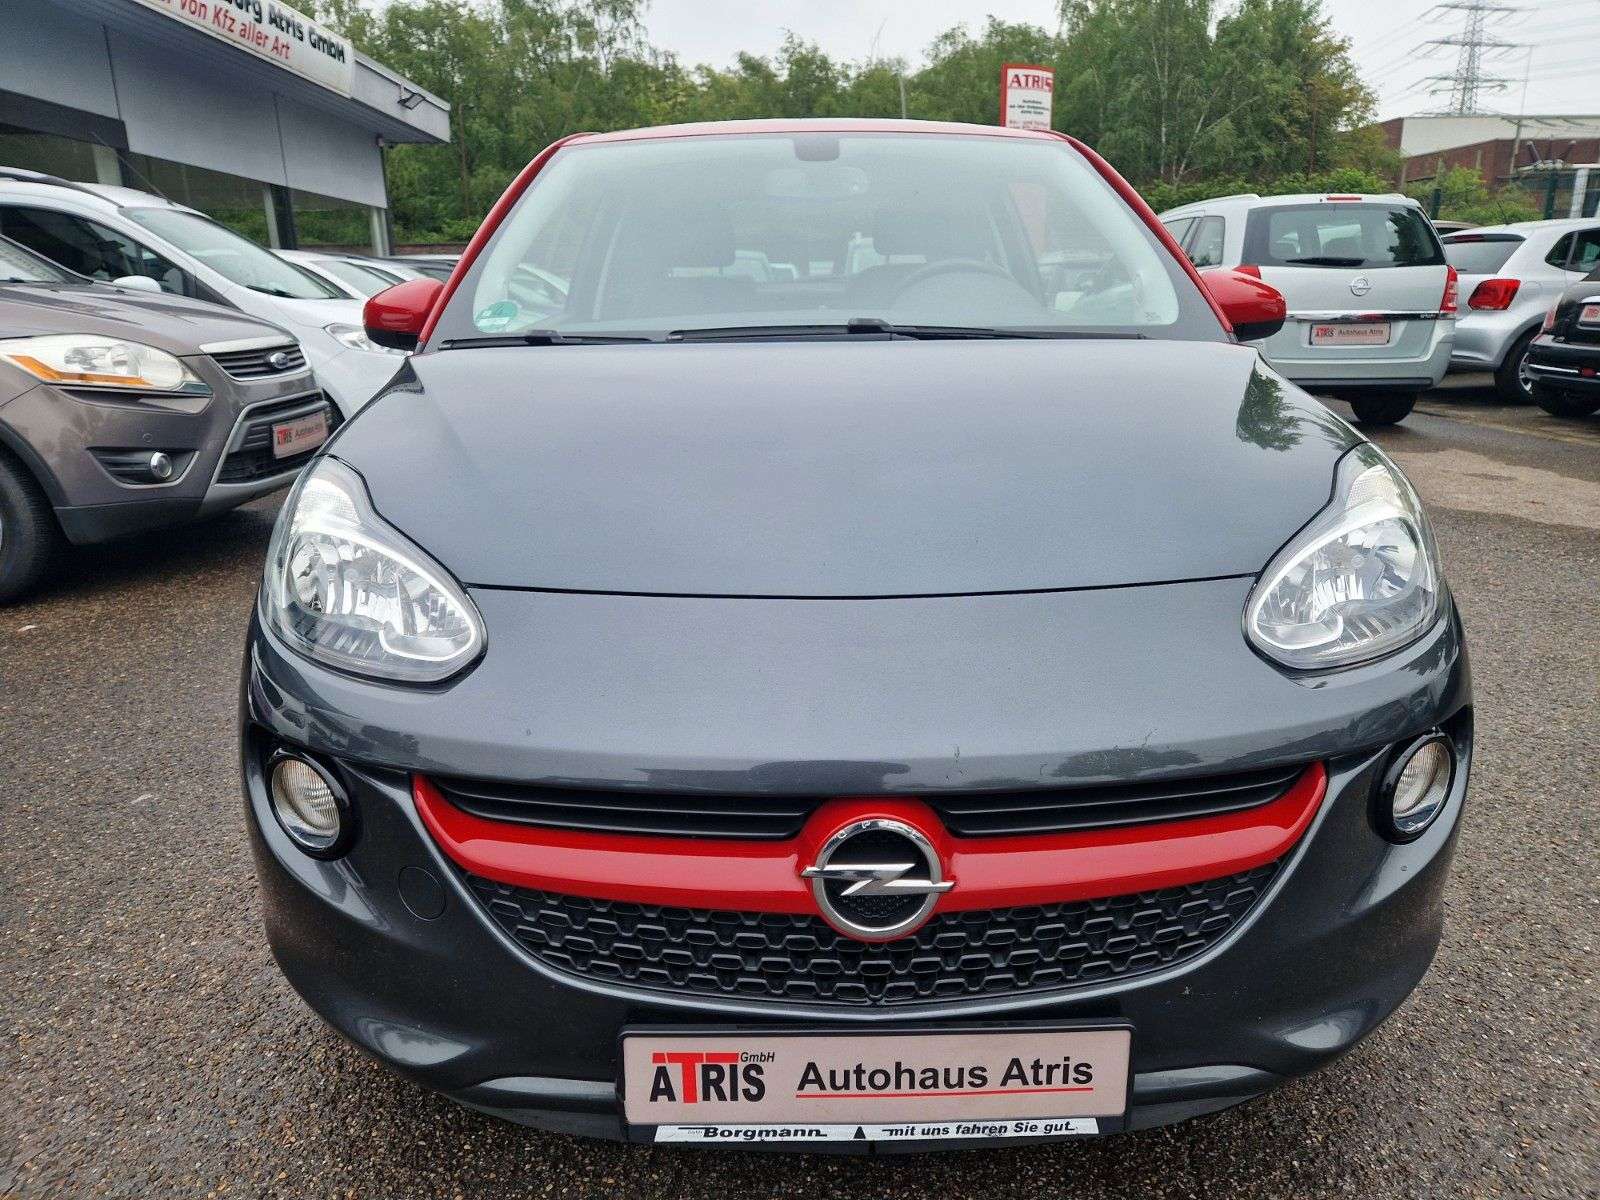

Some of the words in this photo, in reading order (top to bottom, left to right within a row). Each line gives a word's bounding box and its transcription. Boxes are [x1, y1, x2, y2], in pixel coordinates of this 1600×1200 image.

[212, 4, 236, 33] Kfz
[240, 21, 269, 48] aller
[271, 36, 290, 59] Art
[225, 0, 262, 24] urg
[268, 4, 304, 42] Atris
[309, 26, 345, 63] GmbH
[1009, 74, 1052, 93] ATRIS
[740, 1051, 775, 1063] GmbH
[650, 1053, 766, 1103] ATRIS
[797, 1059, 988, 1091] Autohaus
[1000, 1056, 1093, 1087] Atris
[703, 1126, 827, 1140] Borgmann
[882, 1126, 916, 1137] mit
[921, 1126, 949, 1136] uns
[955, 1124, 1008, 1136] fahren
[1013, 1122, 1038, 1133] Sie
[1043, 1121, 1074, 1134] gut
